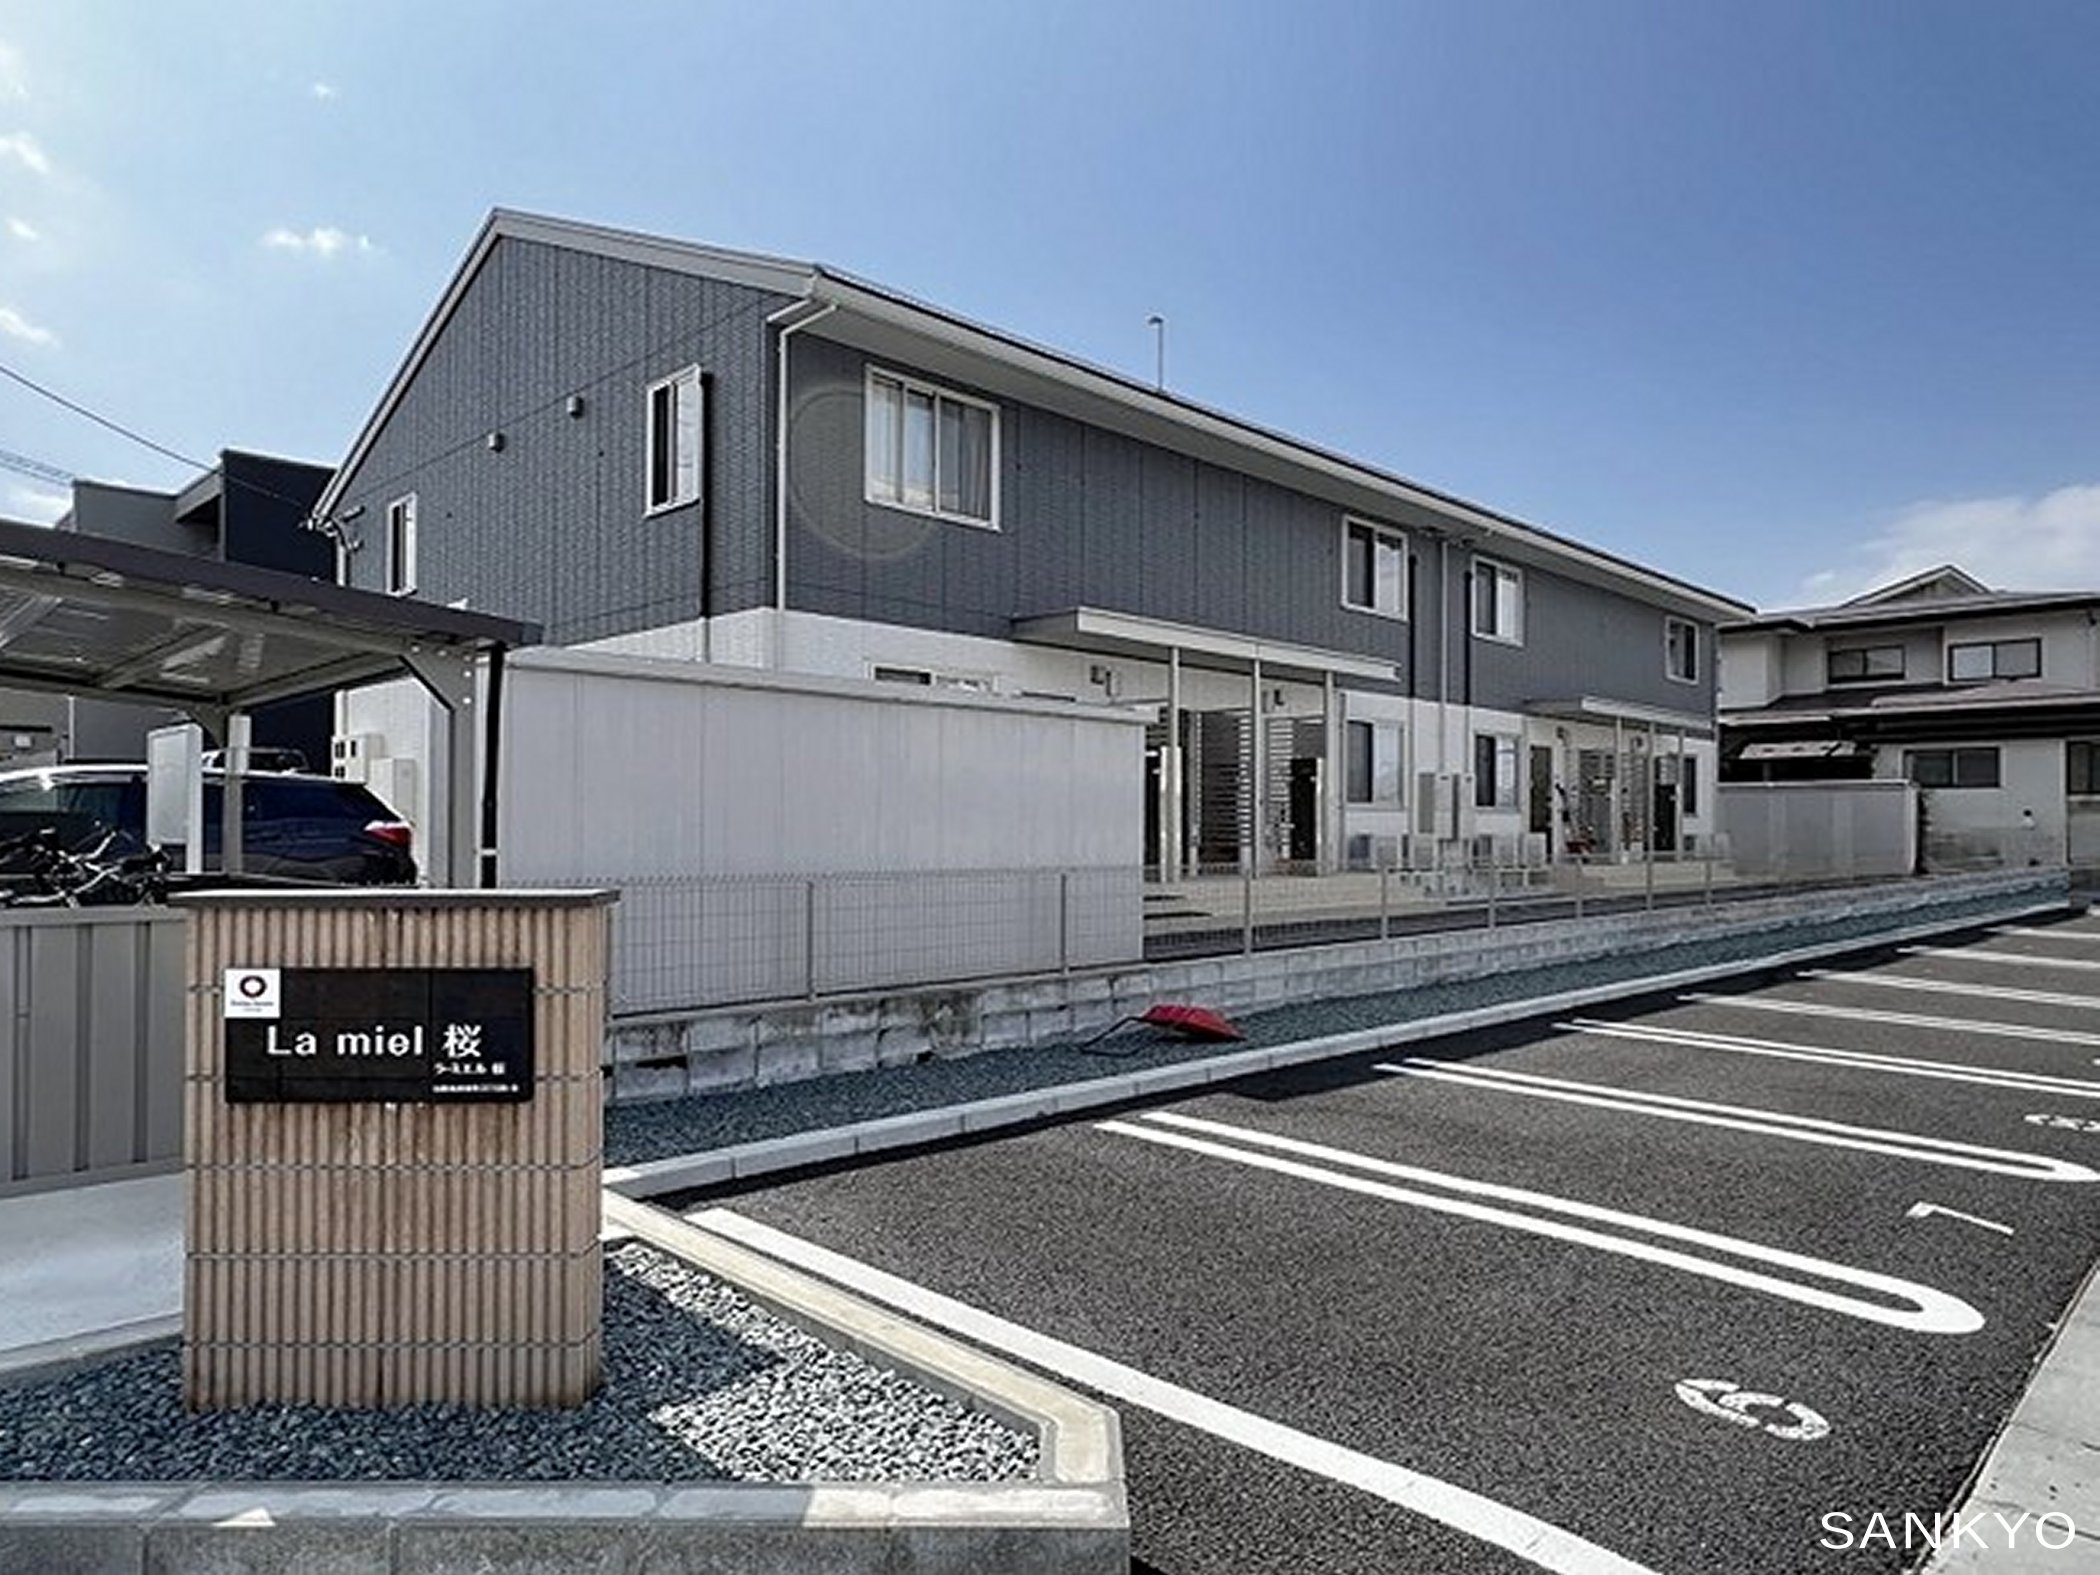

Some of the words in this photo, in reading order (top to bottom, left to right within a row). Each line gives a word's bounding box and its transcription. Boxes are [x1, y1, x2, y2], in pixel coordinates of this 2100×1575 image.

[267, 1025, 316, 1055] La
[337, 1024, 423, 1056] miel
[443, 1023, 481, 1058] 桜
[1674, 1378, 1831, 1440] 6
